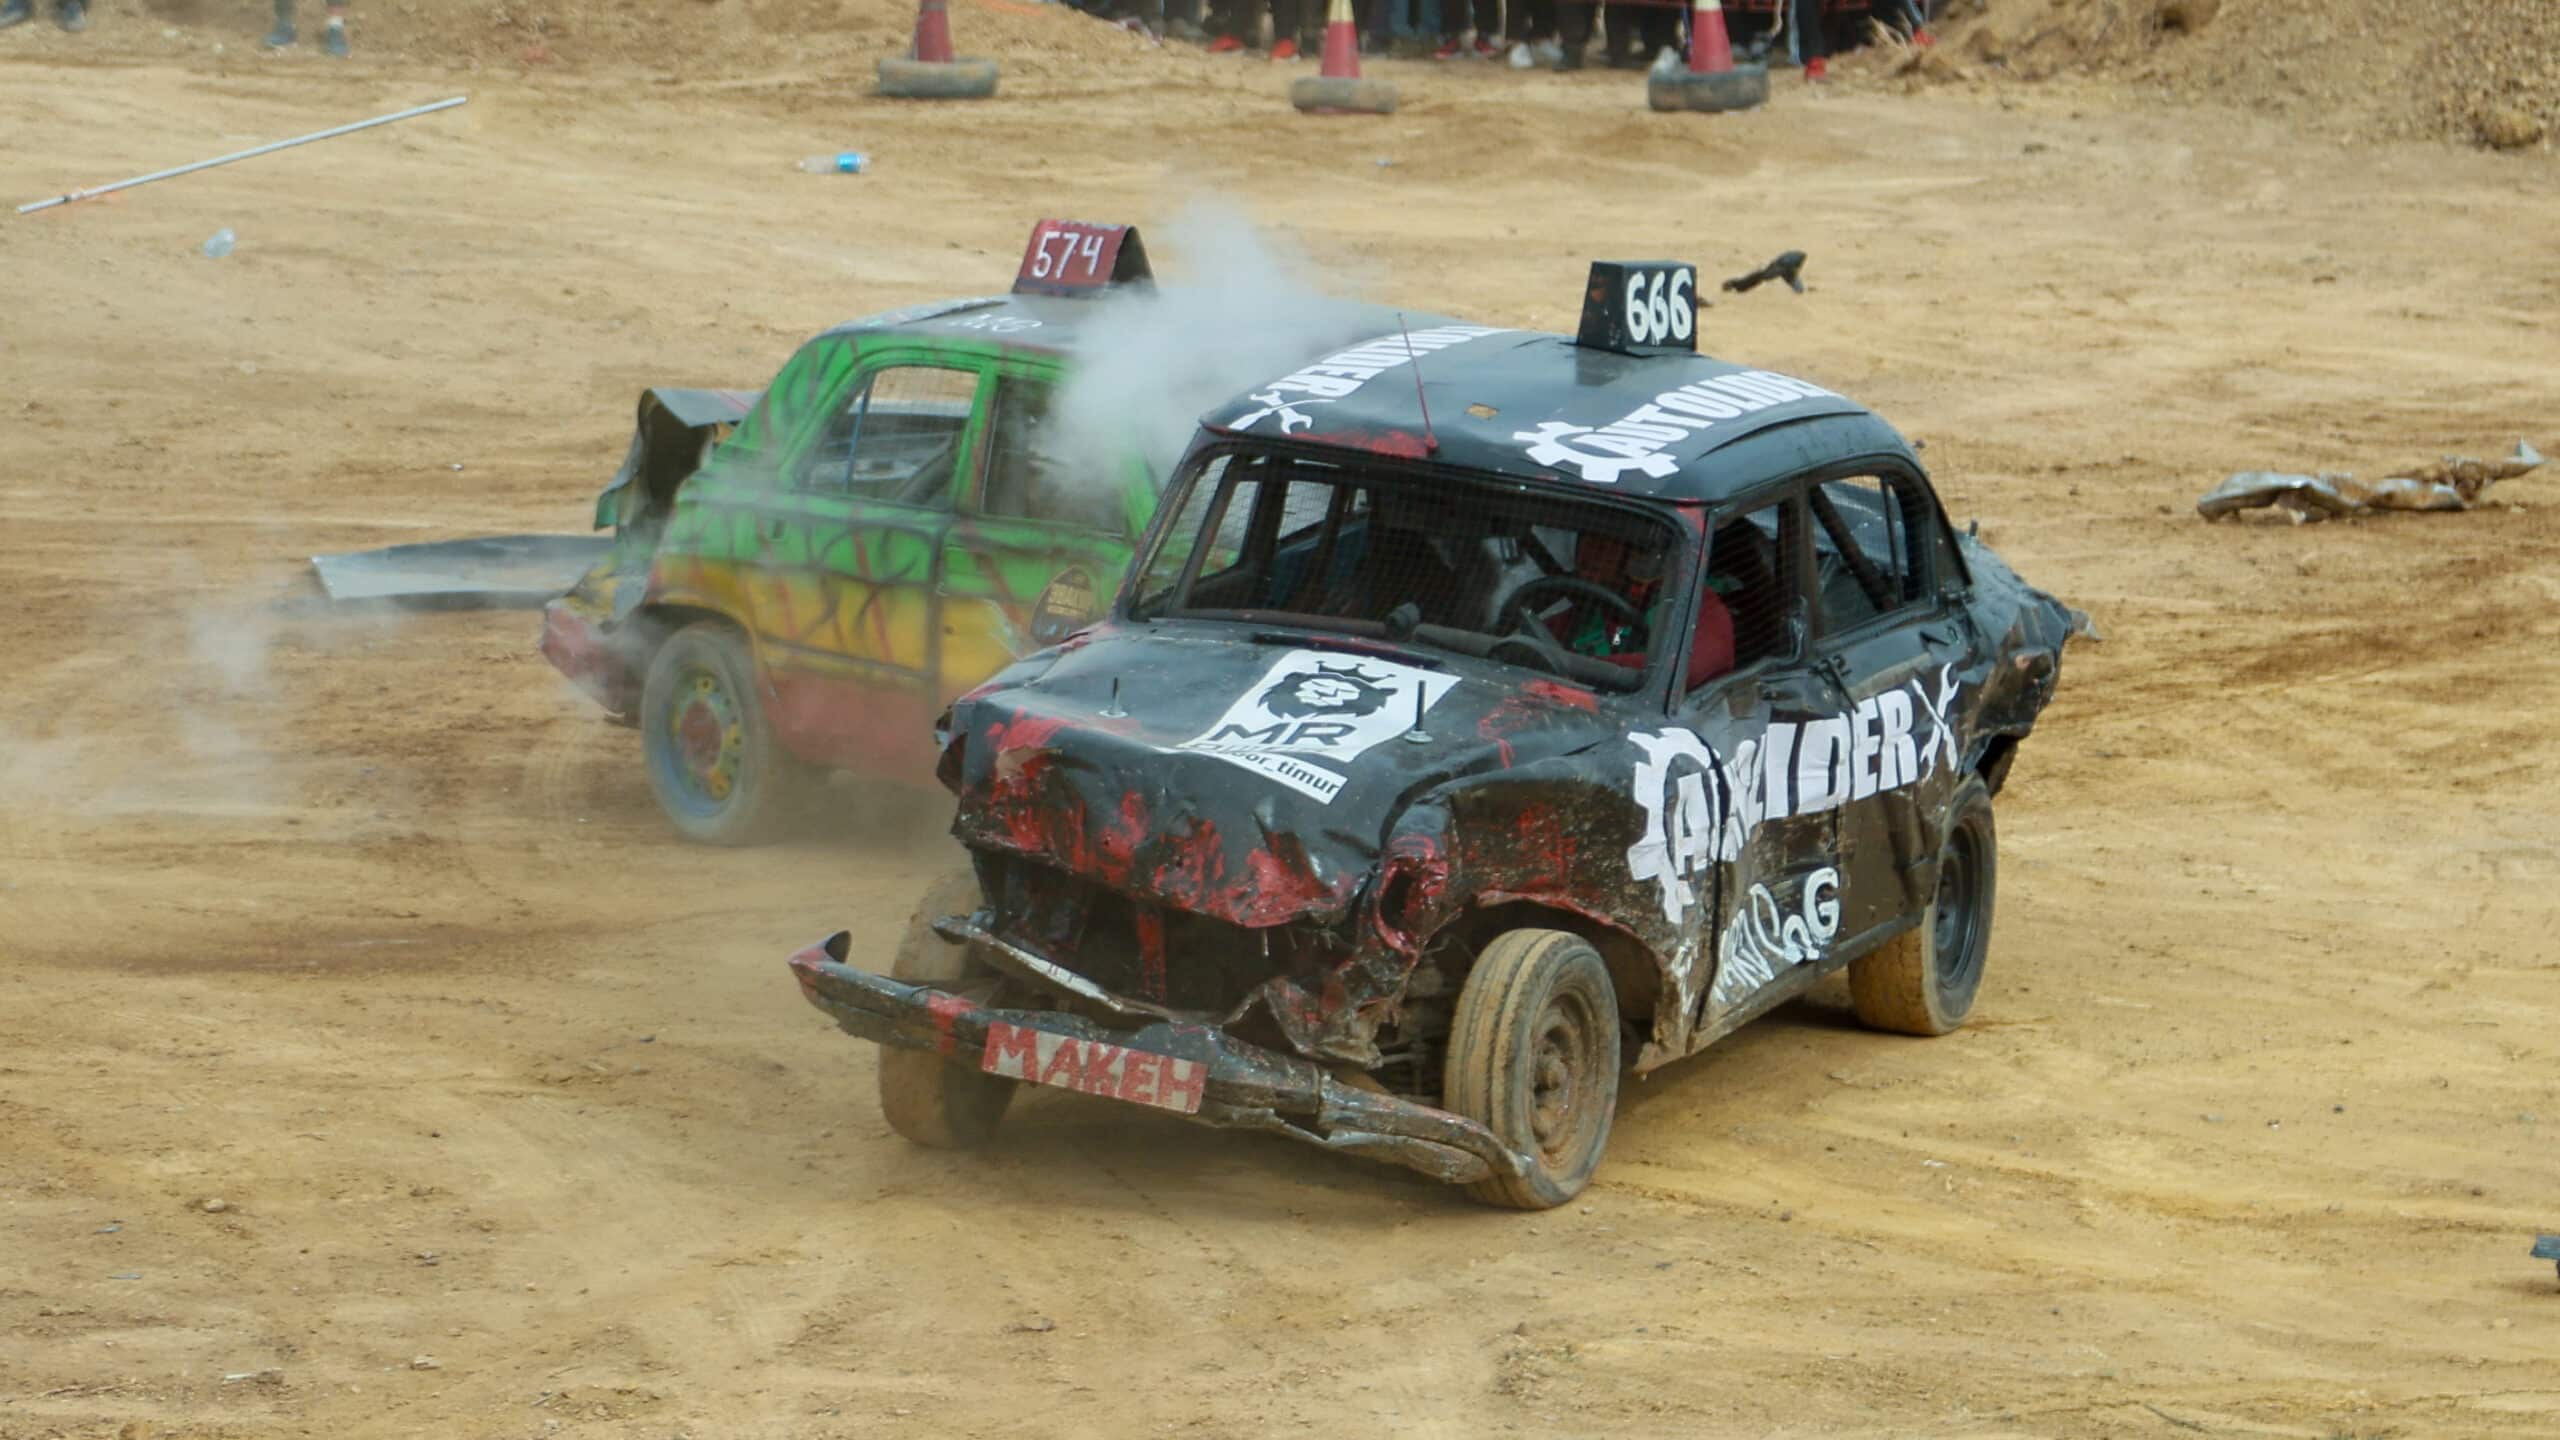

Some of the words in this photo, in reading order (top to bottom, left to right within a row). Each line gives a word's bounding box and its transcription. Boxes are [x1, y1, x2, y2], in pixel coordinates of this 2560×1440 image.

[1032, 231, 1104, 278] 574
[1626, 267, 1693, 345] 666
[1206, 721, 1357, 747] MR
